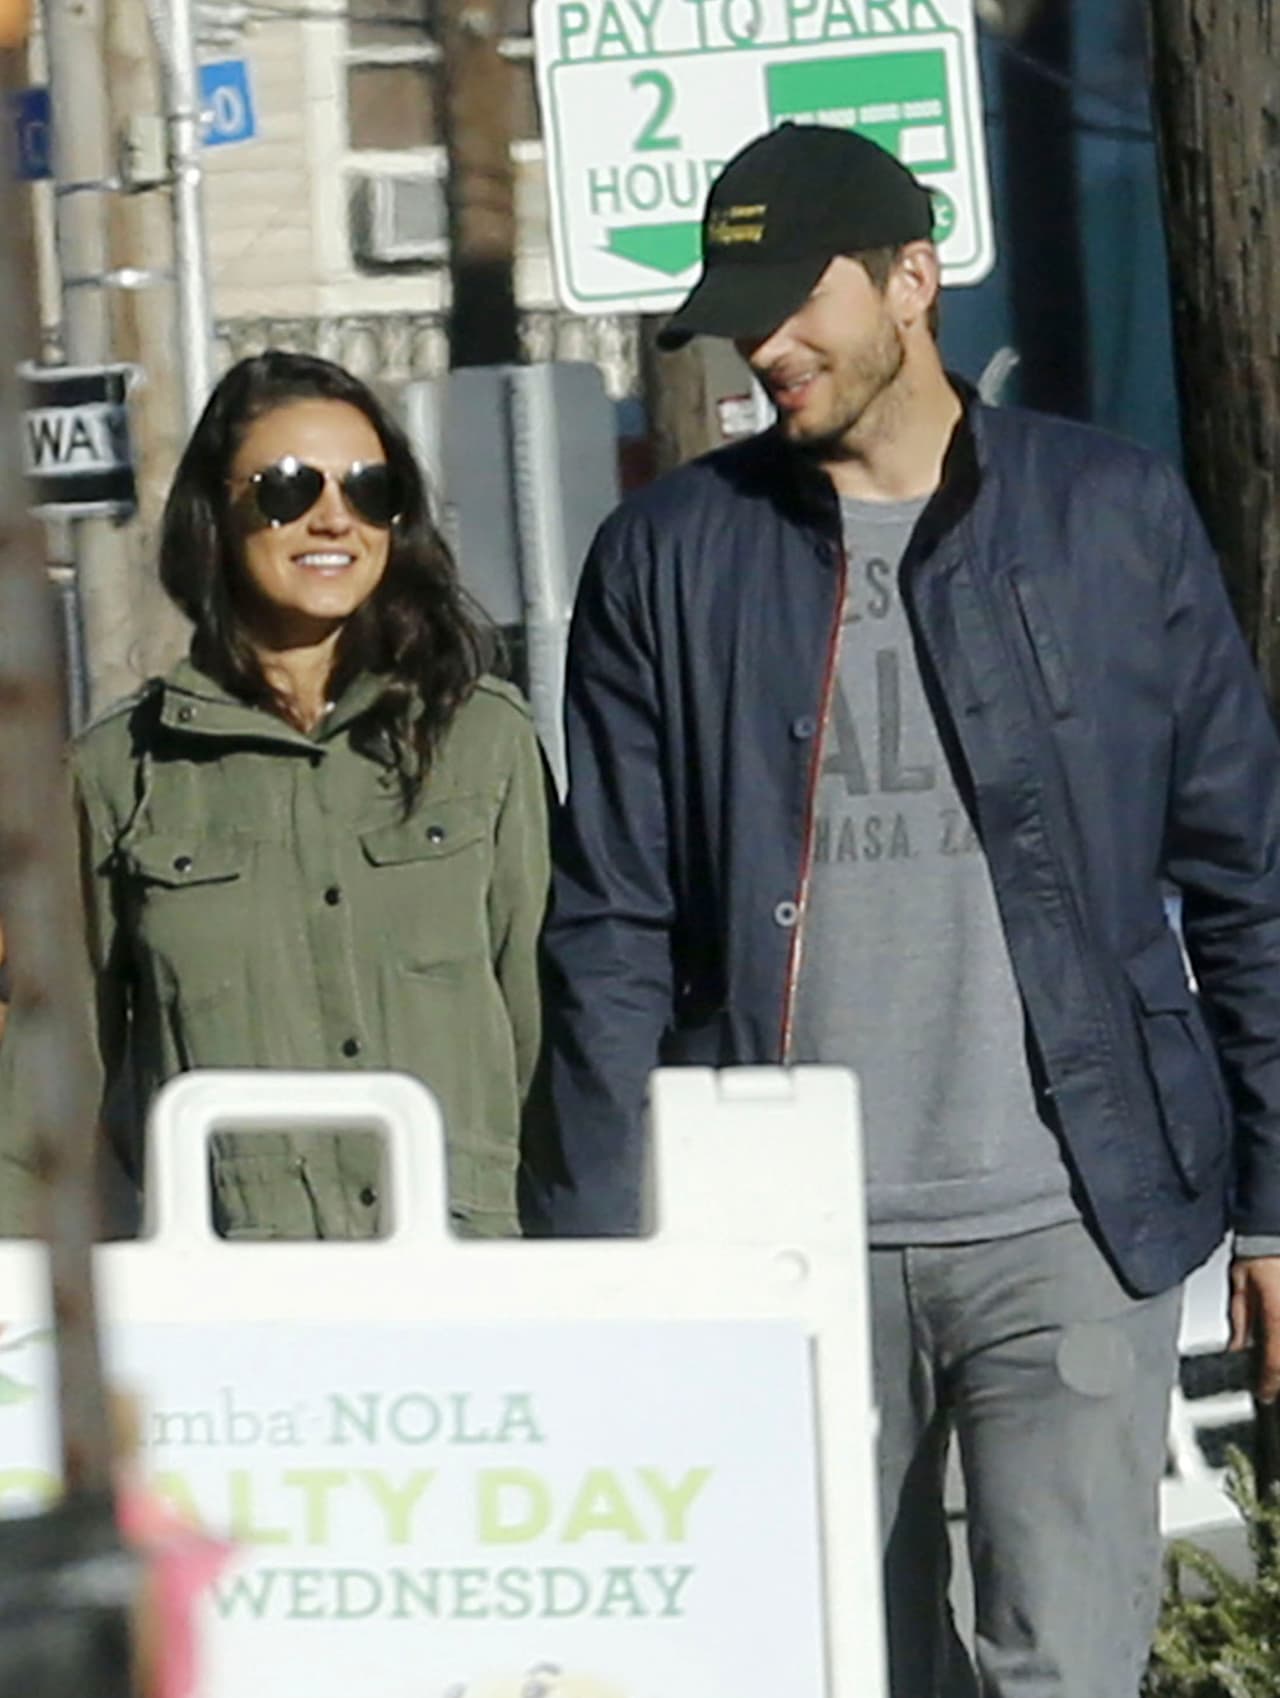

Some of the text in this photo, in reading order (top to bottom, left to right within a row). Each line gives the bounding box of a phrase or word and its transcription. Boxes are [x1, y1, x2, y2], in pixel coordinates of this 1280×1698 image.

[558, 0, 660, 60] PAY
[685, 0, 761, 50] TO
[630, 69, 681, 151] 2
[138, 1386, 546, 1447] mba NOLA
[478, 1466, 713, 1544] DAY
[209, 1566, 693, 1619] WEDNESDAY
